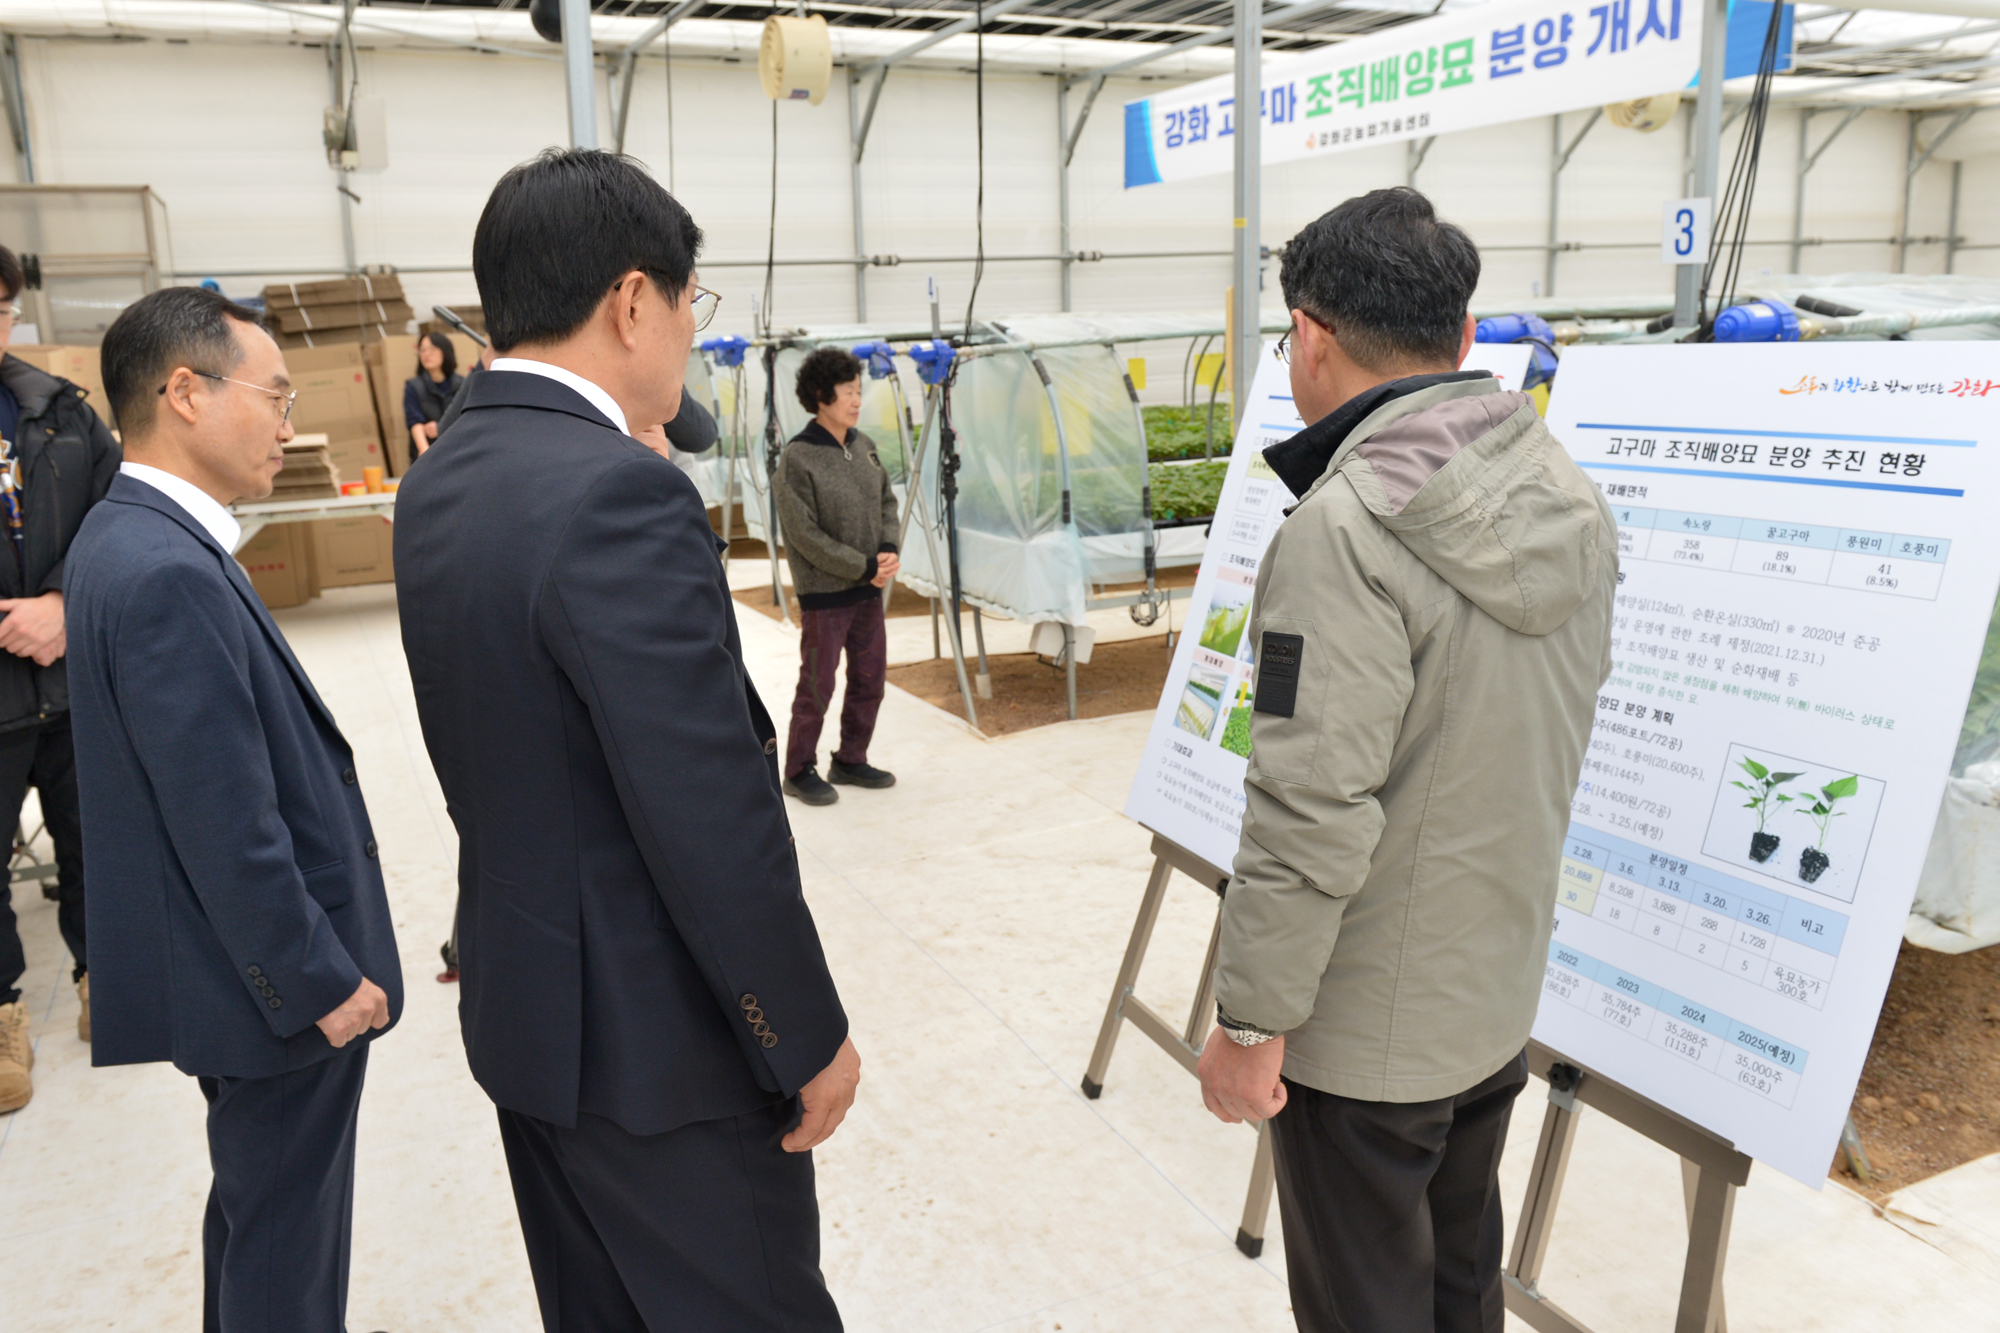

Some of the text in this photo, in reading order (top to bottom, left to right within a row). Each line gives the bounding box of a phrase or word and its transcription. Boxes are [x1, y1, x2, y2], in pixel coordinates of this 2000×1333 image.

[1165, 0, 1682, 149] 강화 고마 조직배양묘 분양 개시
[1675, 208, 1695, 256] 3
[1916, 382, 1945, 394] 만드는
[1948, 378, 2000, 397] 강화
[1605, 437, 1927, 477] 고구마 조직배양묘 분양 추진 현황
[1605, 482, 1649, 499] 재배면적
[1683, 518, 1712, 532] 속노랑
[1766, 526, 1810, 543] 꿀고구마
[1847, 535, 1883, 551] 풍원미
[1683, 539, 1701, 551] 358
[1899, 541, 1939, 558] 호풍미
[1228, 553, 1257, 569] 조직배양묘
[1673, 550, 1704, 563] (73.4%)
[1775, 550, 1789, 561] 89
[1762, 561, 1797, 576] (18.1%)
[1877, 563, 1892, 575] 41
[1865, 575, 1899, 590] (8.5%)
[1633, 619, 1666, 636] 운영에
[1670, 626, 1693, 642] 관한
[1698, 632, 1722, 648] 조례
[1727, 637, 1825, 667] 제정(2021.12.31.)
[1802, 625, 1846, 646] 2020년
[1853, 634, 1881, 652] 준공
[1625, 640, 1679, 661] 조직배양묘
[1685, 651, 1708, 668] 생산
[1714, 657, 1726, 672] 및
[1731, 662, 1781, 683] 순화재배
[1786, 672, 1799, 687] 등
[1627, 662, 1660, 679] 감염되지
[1662, 670, 1680, 683] 않은
[1683, 675, 1718, 692] 생장점을
[1814, 703, 1856, 722] 바이러스
[1861, 713, 1896, 730] 상태로
[1658, 686, 1684, 702] 증식한
[1596, 695, 1675, 726] 양묘 분양 계획
[1172, 741, 1194, 758] 기대효과
[1608, 812, 1664, 841] 3.25.(예정)
[1573, 845, 1594, 861] 2.28.
[1618, 862, 1635, 876] 3.6.
[1648, 853, 1688, 876] 분양일정
[1608, 882, 1635, 899] 8,208
[1658, 876, 1681, 893] 3.13.
[1565, 890, 1578, 902] 30
[1703, 892, 1728, 910] 3.20.
[1609, 907, 1621, 920] 18
[1745, 908, 1772, 926] 3.26.
[1653, 925, 1661, 936] 8
[1700, 916, 1719, 932] 288
[1801, 918, 1824, 936] 비고
[1697, 943, 1706, 954] 2
[1556, 950, 1579, 967] 2022
[1740, 960, 1749, 971] 5
[1616, 976, 1640, 994] 2023
[1773, 966, 1821, 994] 육묘농가
[1545, 979, 1572, 999] (86호)
[1776, 980, 1808, 1003] 300호
[1603, 1006, 1633, 1029] (77호)
[1680, 1005, 1706, 1024] 2024
[1664, 1035, 1701, 1062] (113호)
[1737, 1030, 1796, 1065] 2025(예정)
[1738, 1070, 1772, 1095] (63호)
